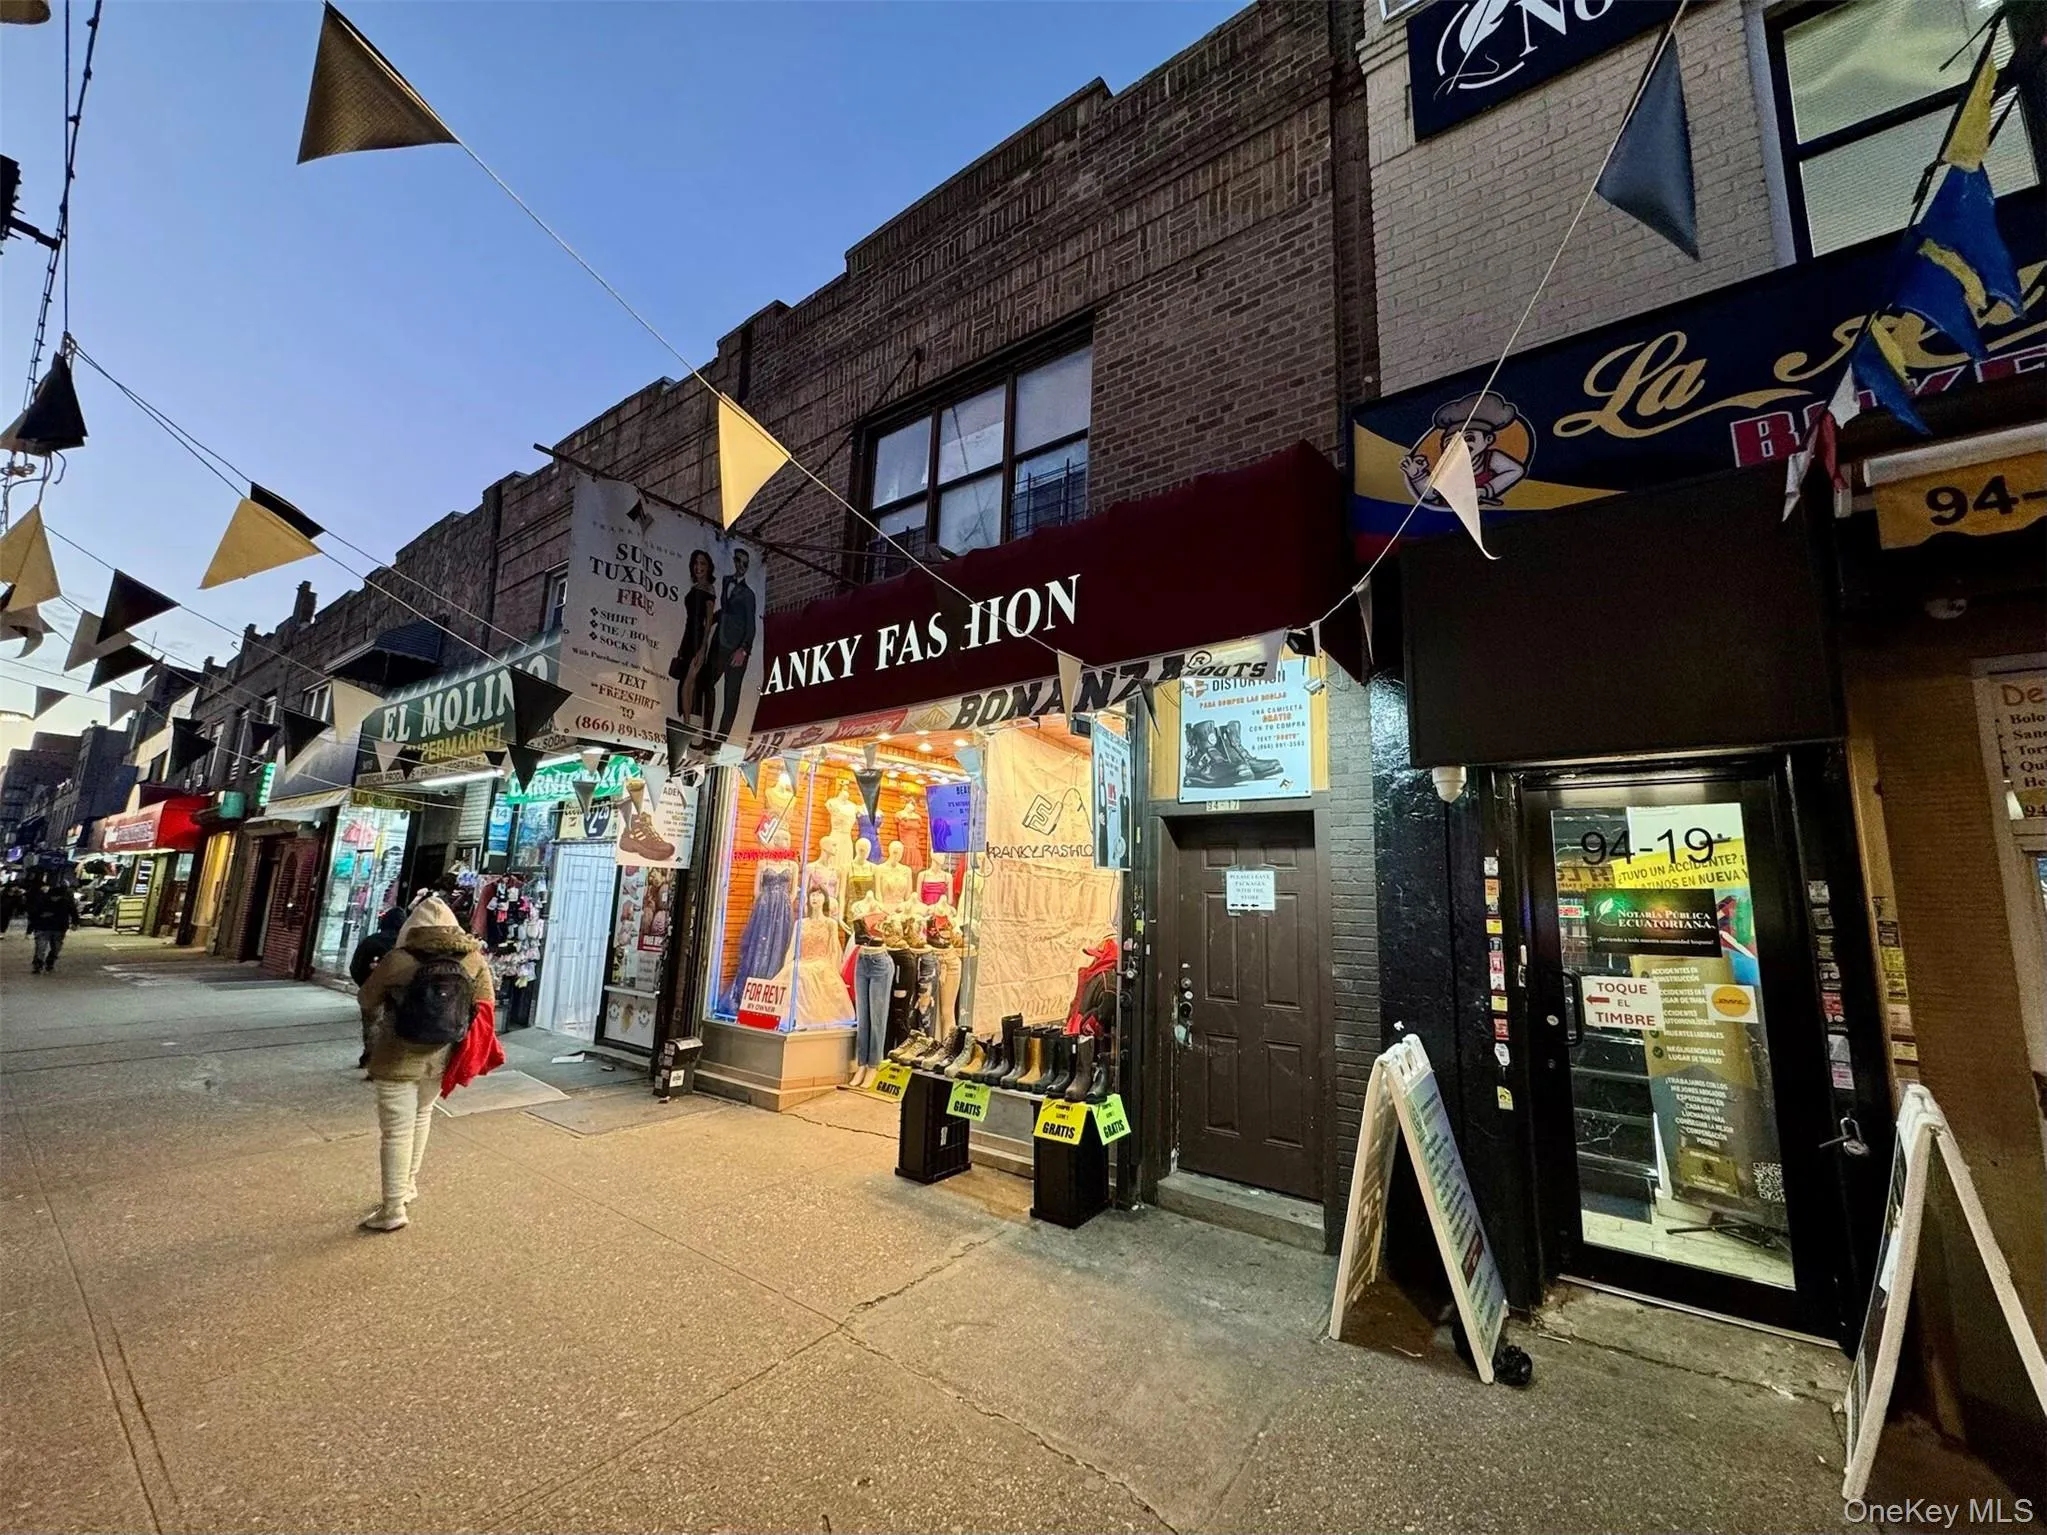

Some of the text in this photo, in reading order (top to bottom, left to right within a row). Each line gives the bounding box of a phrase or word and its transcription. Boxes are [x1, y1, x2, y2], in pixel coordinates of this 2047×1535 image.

[1553, 331, 1752, 437] La
[616, 543, 663, 577] SUTS
[617, 586, 655, 617] FRE
[600, 610, 637, 626] SHIRT
[600, 622, 620, 636] TIE
[600, 635, 637, 653] SOCKS
[761, 635, 862, 696] ANKY
[618, 671, 648, 690] TEXT
[619, 704, 635, 720] TO
[1267, 704, 1303, 714] CAMISETA
[382, 704, 411, 743] EL
[575, 714, 615, 732] (866)
[618, 723, 667, 744] 891-3583
[1276, 721, 1306, 730] COMPRA
[404, 724, 504, 762] PERMARKET
[1580, 827, 1714, 866] 94-19
[1618, 869, 1648, 885] ¿TUVO
[1650, 866, 1666, 877] UN
[1667, 853, 1738, 874] ACCIDENTE?
[1681, 875, 1699, 887] EN
[1699, 870, 1741, 885] NUEVA
[1665, 910, 1711, 920] PÚBLICA
[1618, 918, 1713, 930] ECUATORIANA
[744, 982, 787, 1005] FOR RENT
[1596, 982, 1648, 995] TOQUE
[1617, 999, 1631, 1008] EL
[1595, 1011, 1657, 1027] TIMBRE
[1664, 1009, 1698, 1017] CCIDENTES
[876, 1081, 901, 1097] GRATIS
[953, 1100, 982, 1117] GRATIS
[1042, 1121, 1076, 1139] GRATIS
[1103, 1119, 1125, 1139] GRATIS
